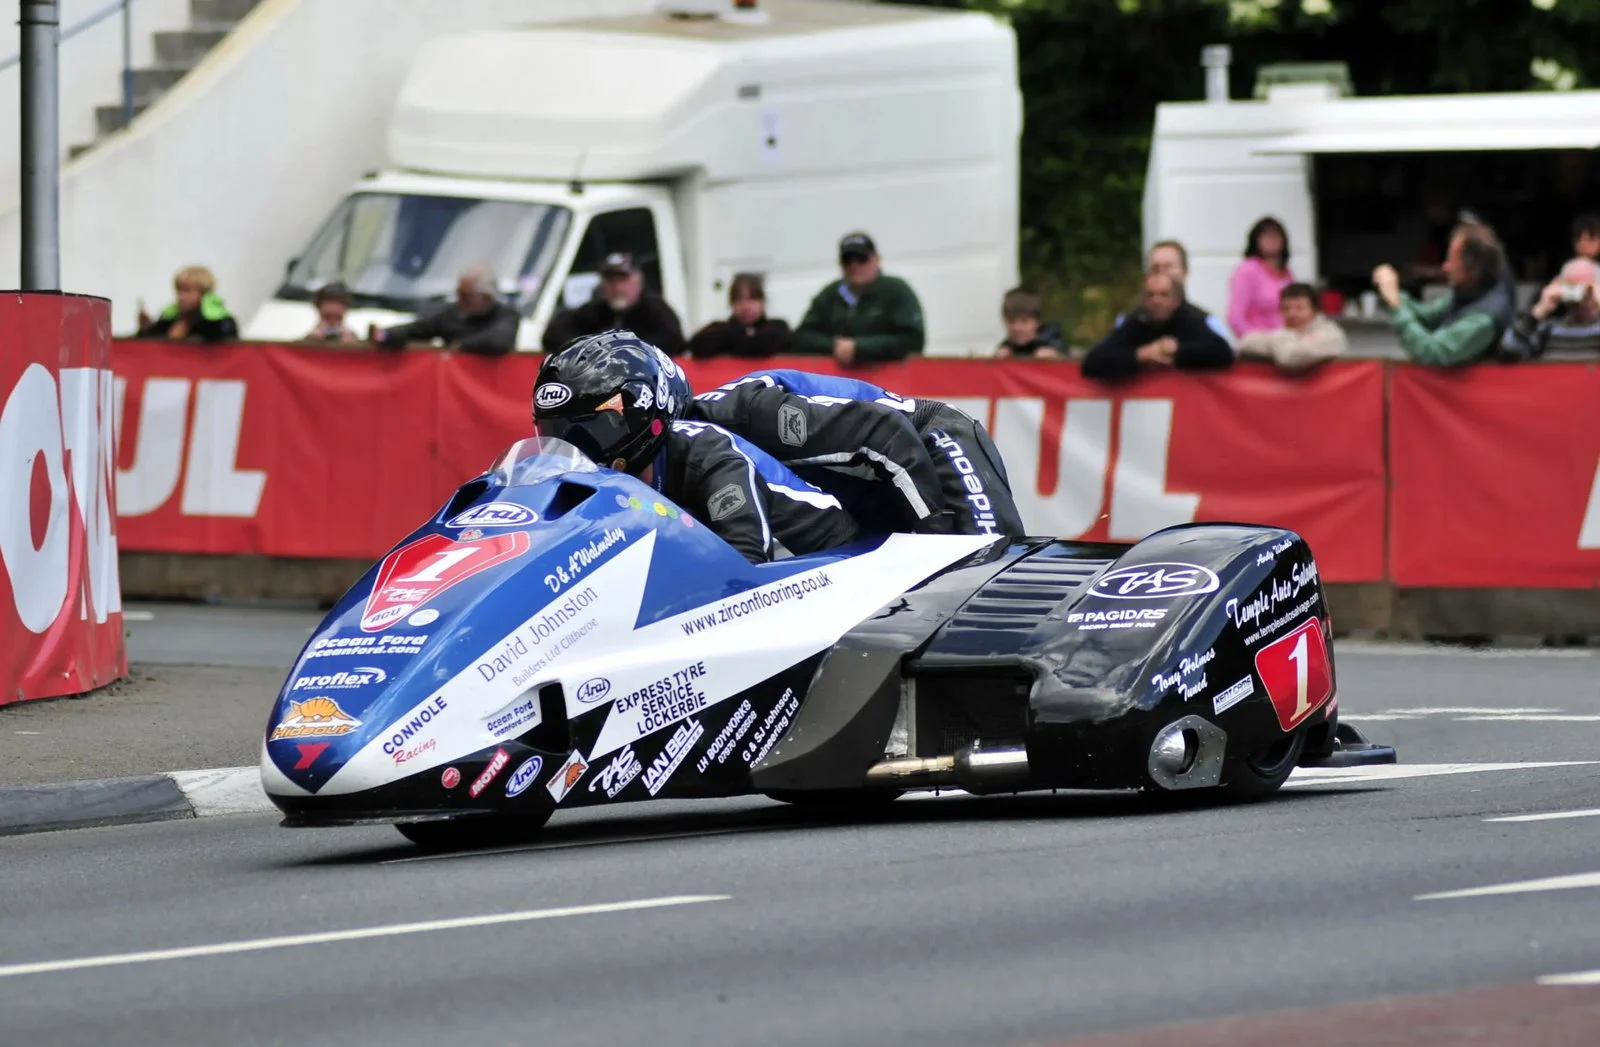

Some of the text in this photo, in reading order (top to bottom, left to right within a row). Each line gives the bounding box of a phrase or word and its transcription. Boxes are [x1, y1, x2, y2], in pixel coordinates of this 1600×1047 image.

[536, 387, 564, 401] Arai
[468, 506, 526, 521] Arai
[396, 547, 481, 582] 1
[1099, 568, 1199, 594] TAS
[681, 570, 833, 636] www.zirconflooring.co.uk
[1226, 590, 1270, 629] Temple
[1271, 577, 1292, 613] Auto
[1244, 592, 1319, 646] www.templeautosalvage.com
[306, 645, 421, 659] oceanford.com
[314, 634, 428, 650] Ocean Ford
[477, 587, 598, 682] David Johnston
[511, 618, 599, 687] Builders Ltd Clitheroe
[292, 672, 374, 691] proflex
[616, 661, 706, 714] EXPRESS TYRE
[1152, 647, 1216, 692] Tony Holmes
[1178, 672, 1208, 702] Tuned
[1289, 632, 1312, 722] 1
[487, 700, 533, 731] Ocean Ford
[637, 692, 707, 735] LOCKERBIE
[642, 682, 694, 717] SERVICE
[785, 697, 799, 717] Ltd
[270, 724, 351, 741] Hideout
[383, 696, 448, 754] CONNOLE
[697, 699, 751, 773] LH BODYWORKS
[742, 688, 793, 761] G & SJ Johnson
[392, 738, 436, 767] Racing
[588, 744, 635, 791] TAS
[641, 717, 700, 789] IAN BELL
[471, 752, 508, 795] MOTUL
[511, 761, 537, 787] Arai
[606, 759, 643, 798] RACING
